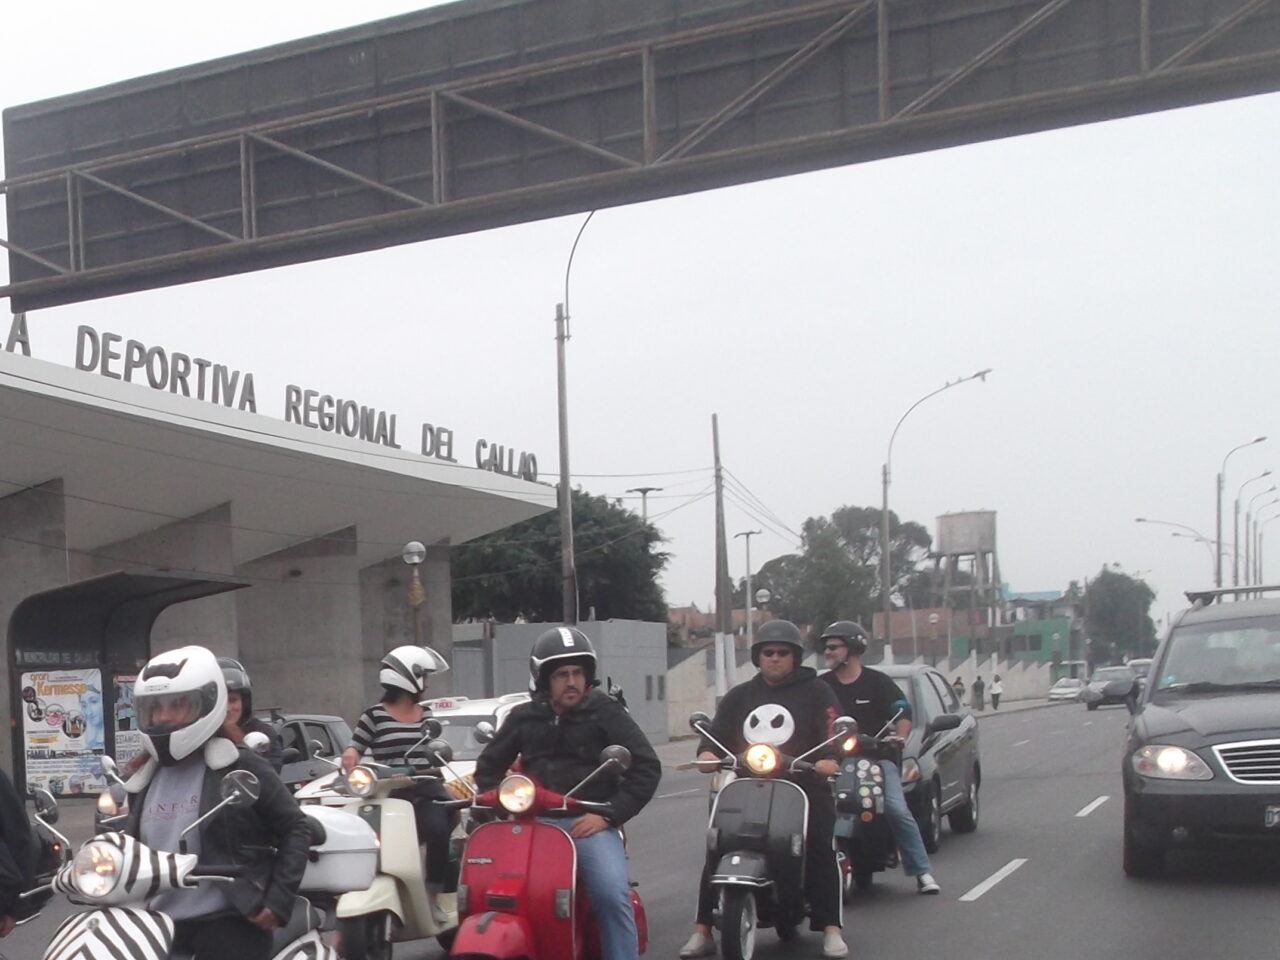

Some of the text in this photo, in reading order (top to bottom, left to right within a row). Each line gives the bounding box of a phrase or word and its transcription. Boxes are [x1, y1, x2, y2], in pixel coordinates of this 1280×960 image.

[75, 324, 257, 414] DEPORTIVA
[284, 383, 402, 450] REGIONAL
[421, 422, 458, 464] DEL
[475, 438, 538, 483] CALLAO
